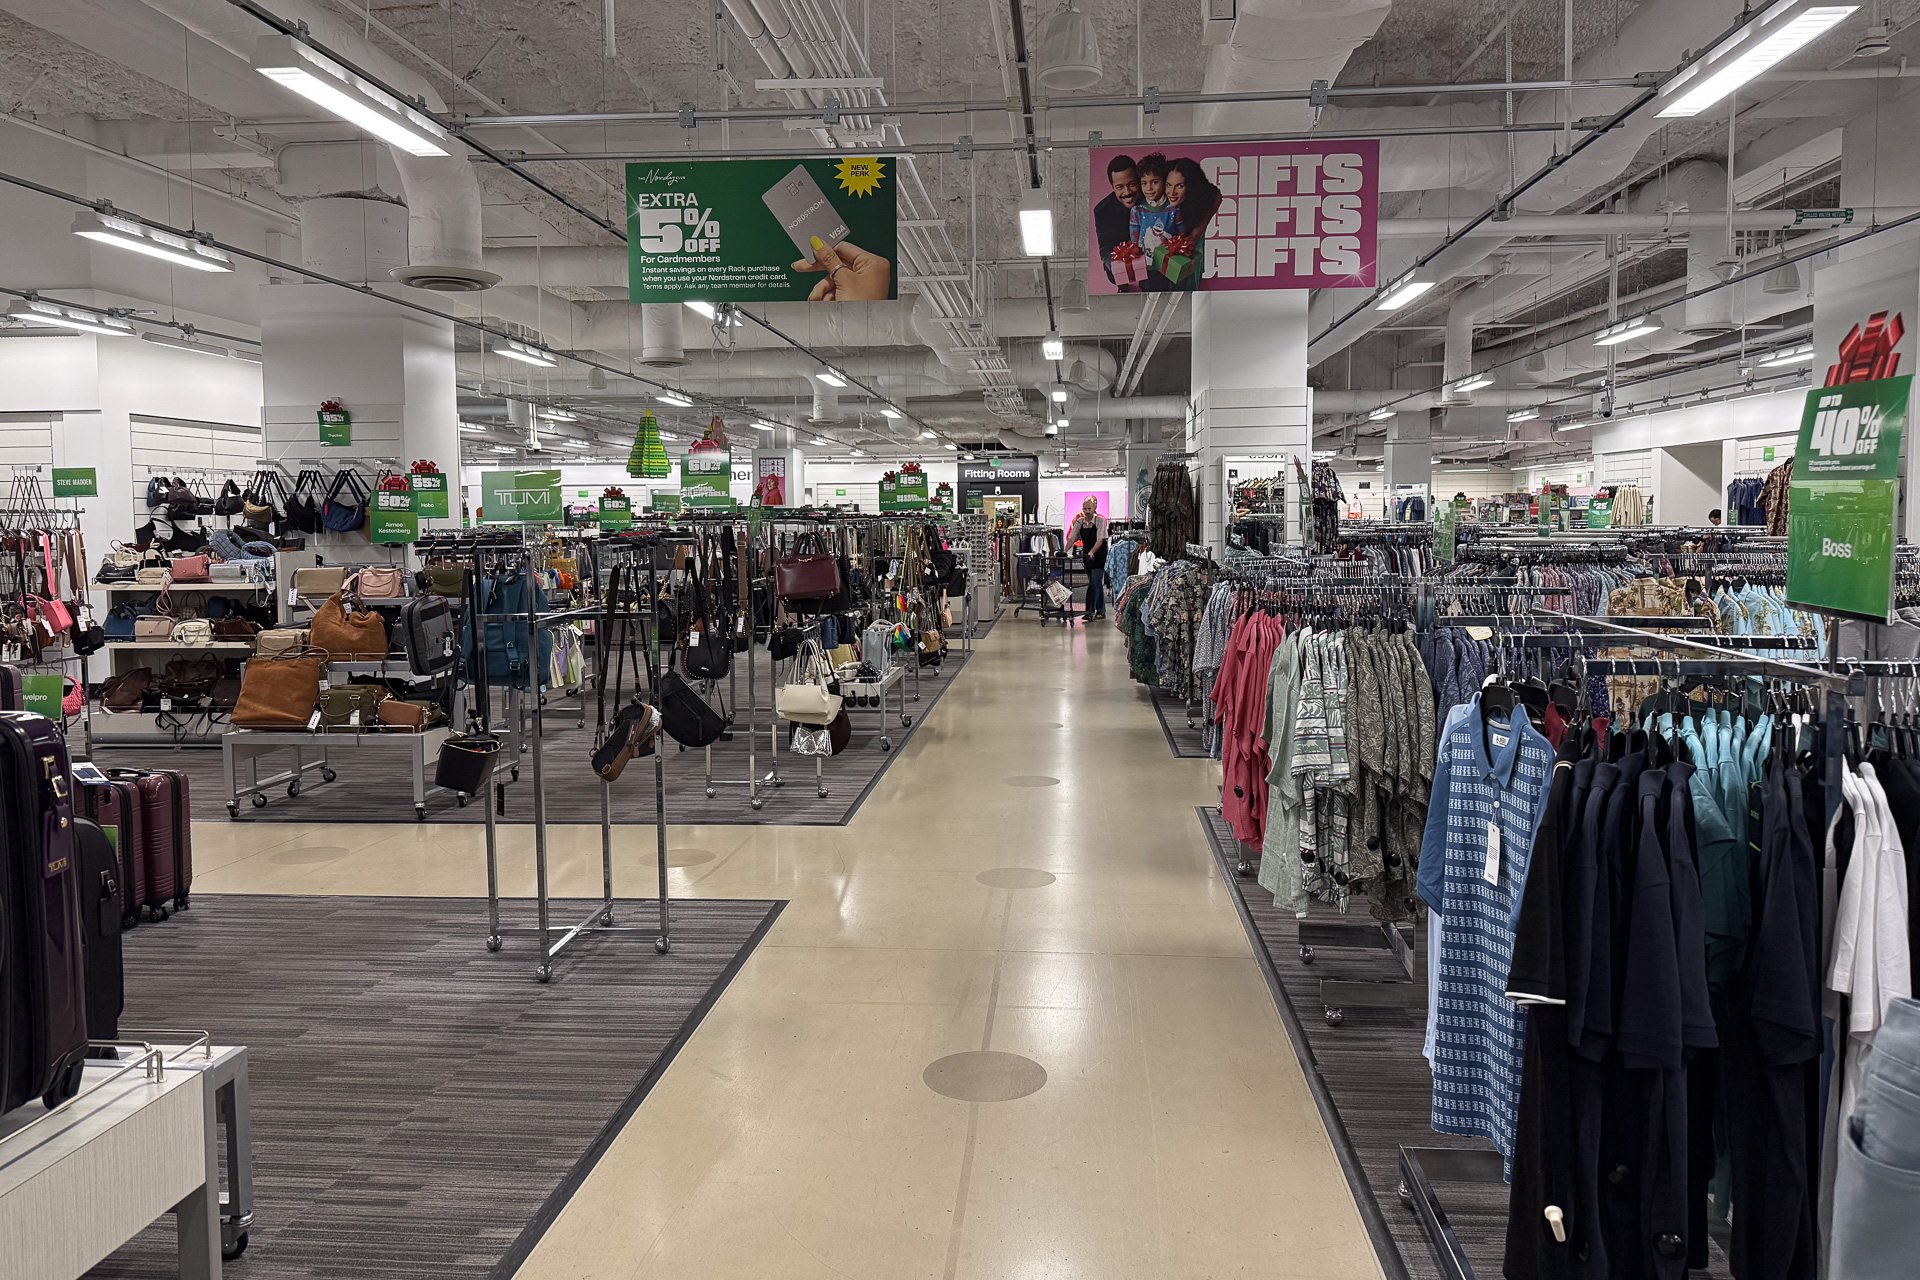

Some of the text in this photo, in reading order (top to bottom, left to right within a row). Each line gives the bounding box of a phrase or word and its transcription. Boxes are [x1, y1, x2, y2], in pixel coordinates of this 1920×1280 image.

[644, 169, 678, 186] Nordy
[1200, 153, 1364, 196] GIFTS
[638, 192, 698, 207] EXTRA
[788, 198, 825, 231] NORDSTROM
[1204, 194, 1362, 238] GIFTS
[640, 208, 720, 253] 5%
[829, 224, 846, 239] VISA
[684, 238, 720, 252] OFF
[657, 255, 721, 263] Cardmembers
[1202, 236, 1361, 279] GIFTS
[1818, 394, 1843, 408] UP TO
[1810, 404, 1880, 456] 40%
[1855, 438, 1878, 454] OFF
[964, 470, 995, 480] Fitting
[378, 495, 411, 507] 50%
[494, 488, 550, 505] TUMI
[1822, 538, 1852, 558] Boss
